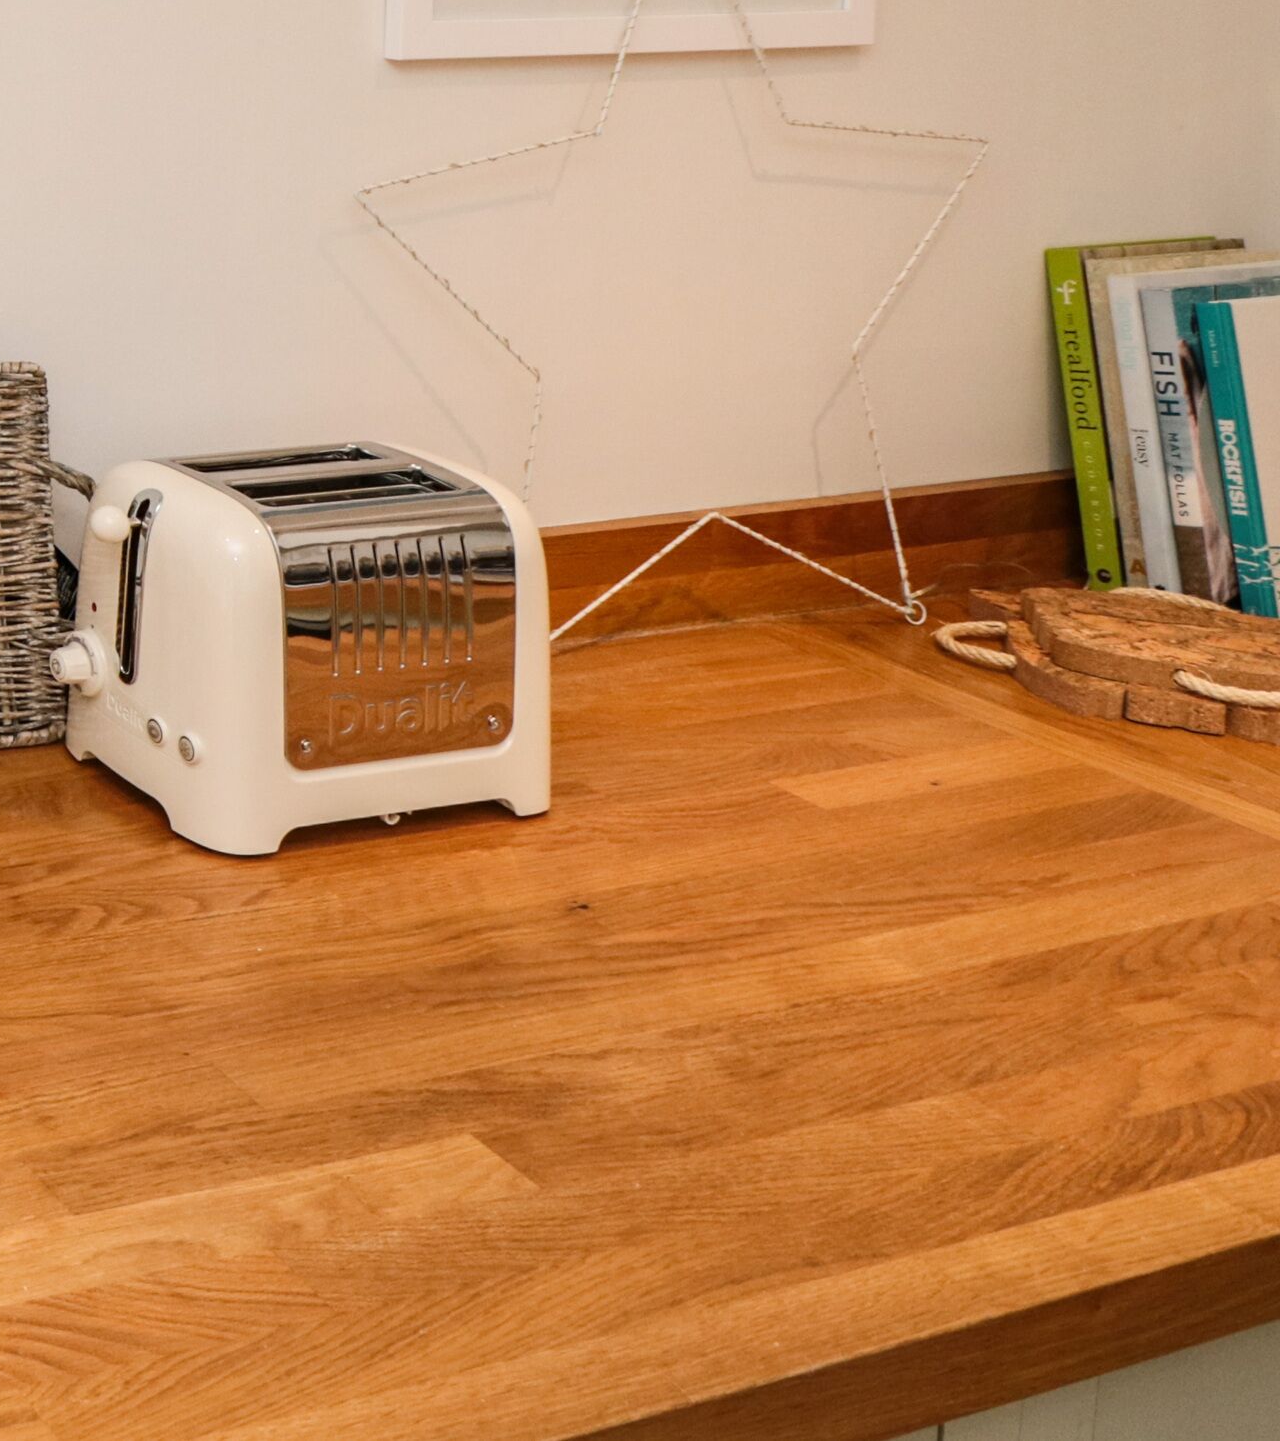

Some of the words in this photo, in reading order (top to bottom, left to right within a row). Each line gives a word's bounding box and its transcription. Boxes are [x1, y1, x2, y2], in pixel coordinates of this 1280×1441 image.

[1151, 351, 1181, 416] FISH
[1167, 432, 1182, 459] MAT
[1218, 418, 1249, 516] ROCKFISH
[1172, 465, 1189, 518] FOLLAS
